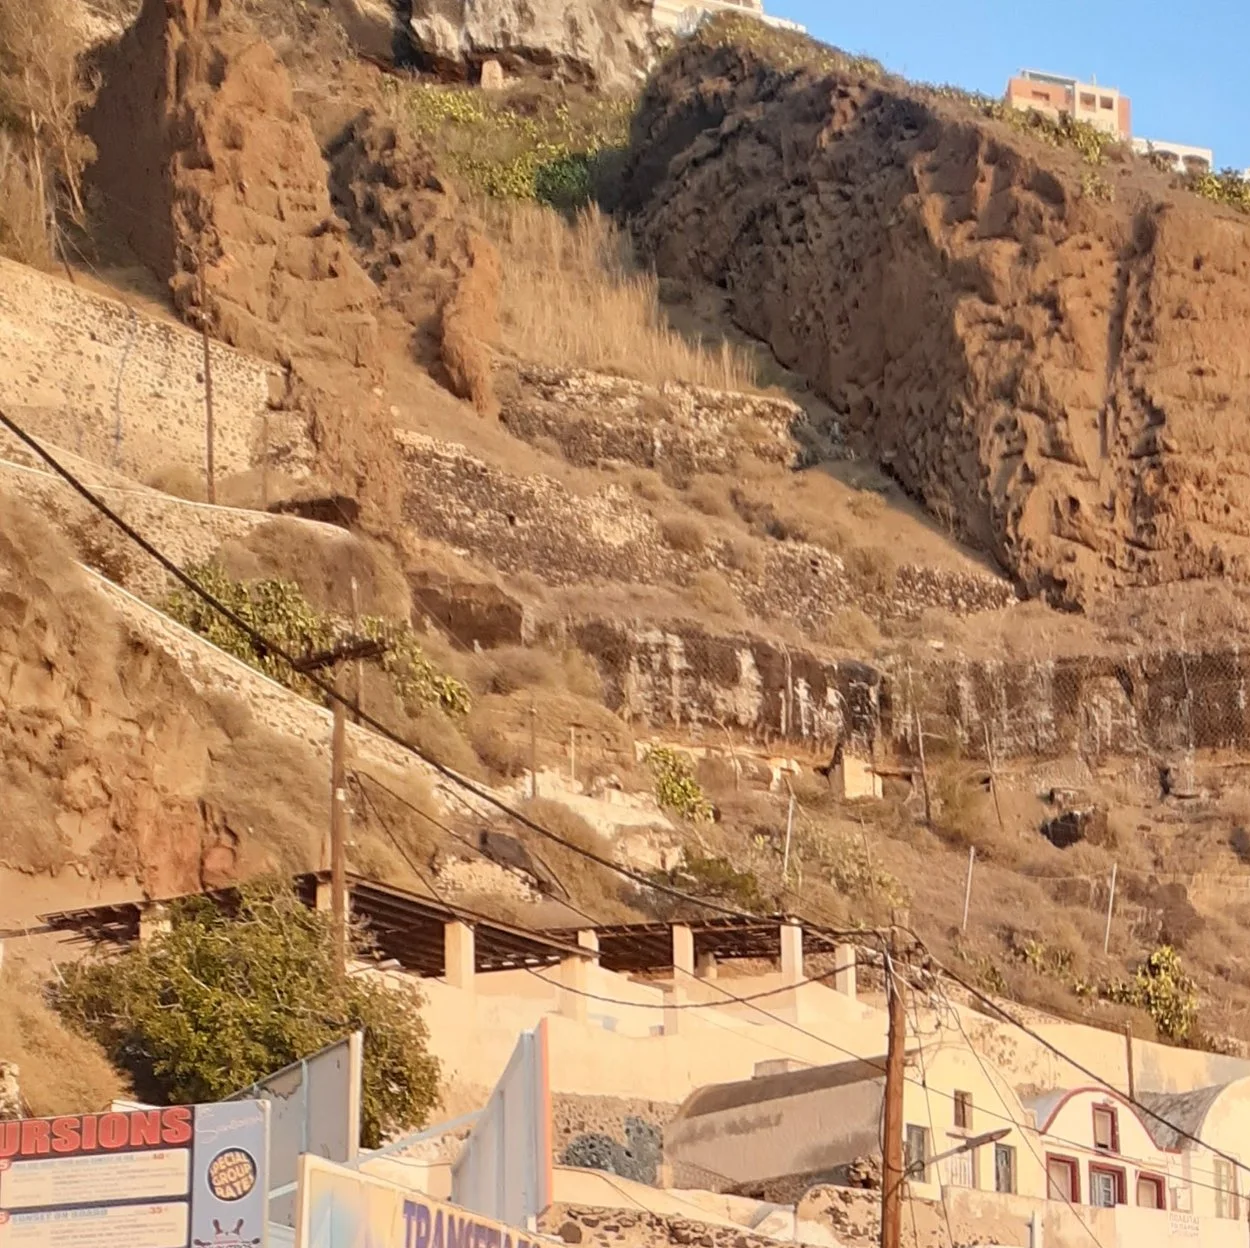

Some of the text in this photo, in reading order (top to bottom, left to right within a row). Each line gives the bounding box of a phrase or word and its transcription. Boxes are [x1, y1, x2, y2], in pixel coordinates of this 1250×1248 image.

[0, 1107, 193, 1157] URSIONS
[210, 1151, 249, 1176] SPECIAL
[212, 1163, 252, 1186] GROUP
[215, 1175, 254, 1198] RATES
